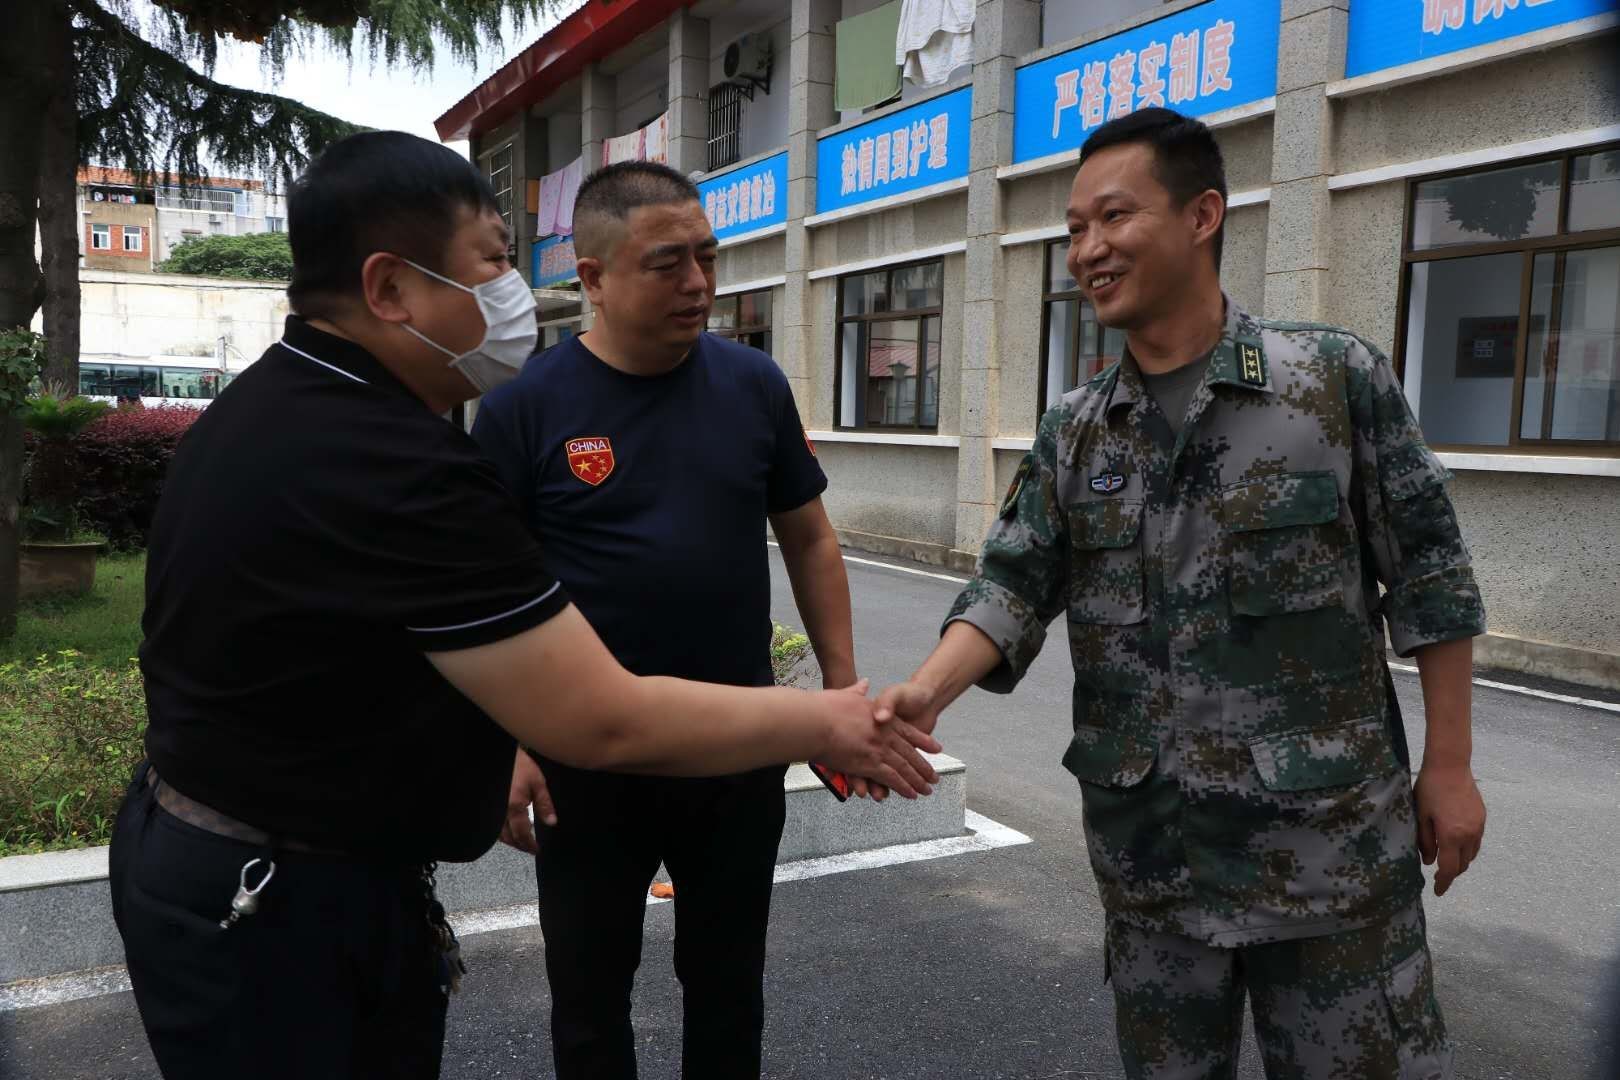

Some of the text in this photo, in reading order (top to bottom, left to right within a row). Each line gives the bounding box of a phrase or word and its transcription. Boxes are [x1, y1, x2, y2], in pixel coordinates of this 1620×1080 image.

[1053, 19, 1235, 138] 严格落实制度
[841, 112, 948, 197] 热情周到护理
[570, 440, 607, 453] CHINA
